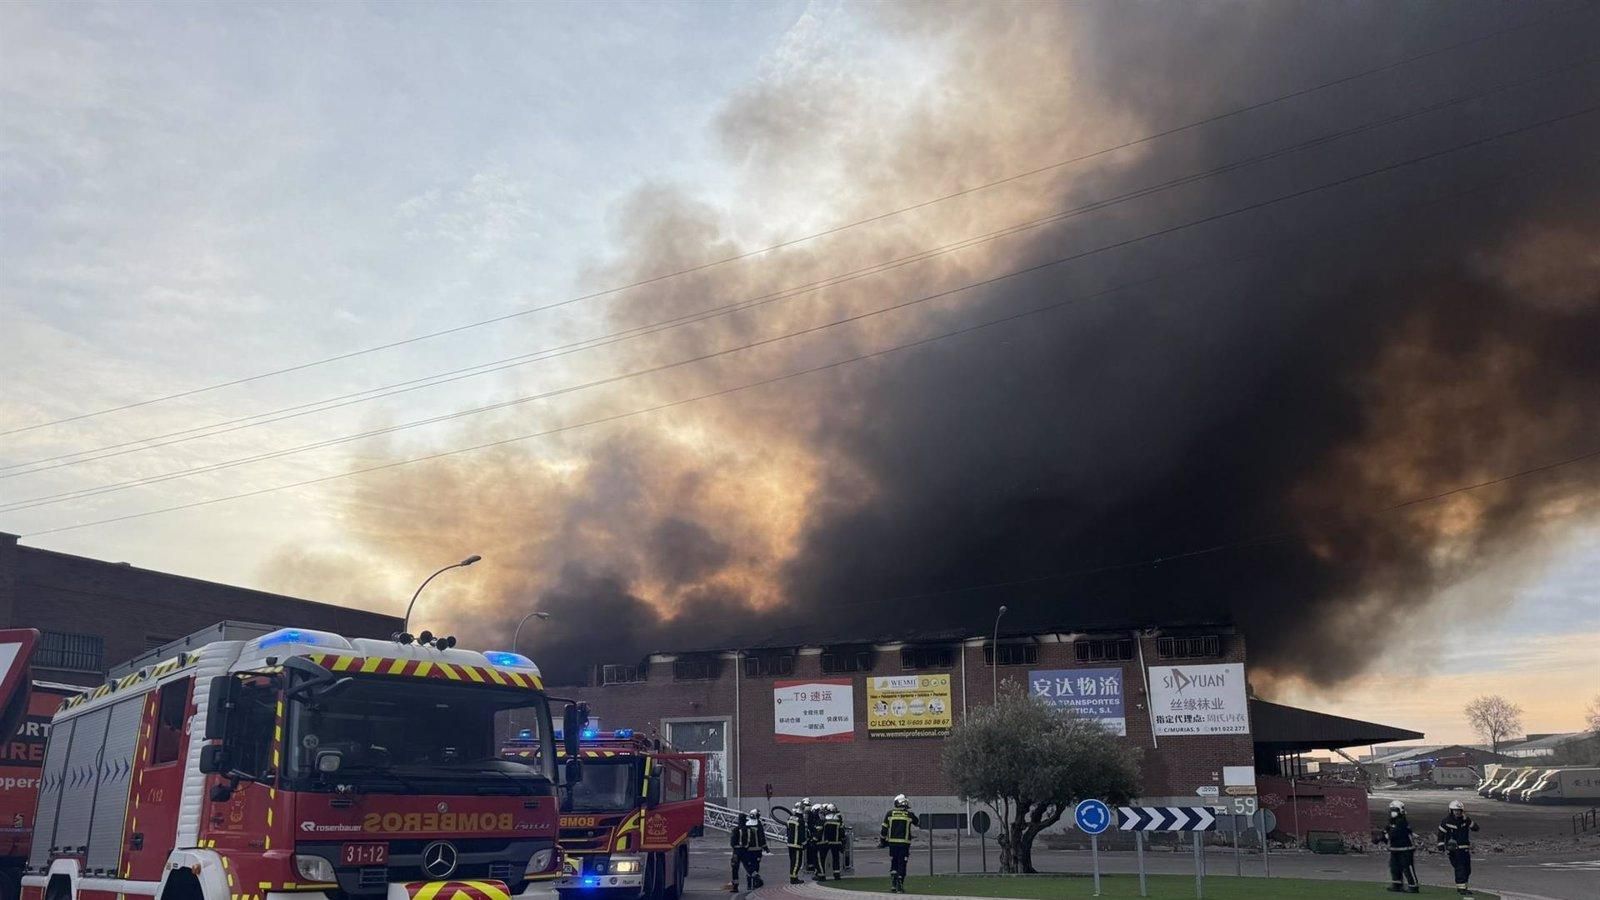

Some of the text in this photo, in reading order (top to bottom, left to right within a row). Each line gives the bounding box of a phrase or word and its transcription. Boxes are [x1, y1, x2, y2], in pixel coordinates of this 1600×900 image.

[1033, 676, 1121, 697] 安达物流
[794, 691, 832, 701] T9 速运
[1170, 697, 1225, 711] 丝缘袜业
[1234, 797, 1256, 815] 59
[317, 823, 361, 831] rosenbauer
[347, 846, 385, 862] 31-12
